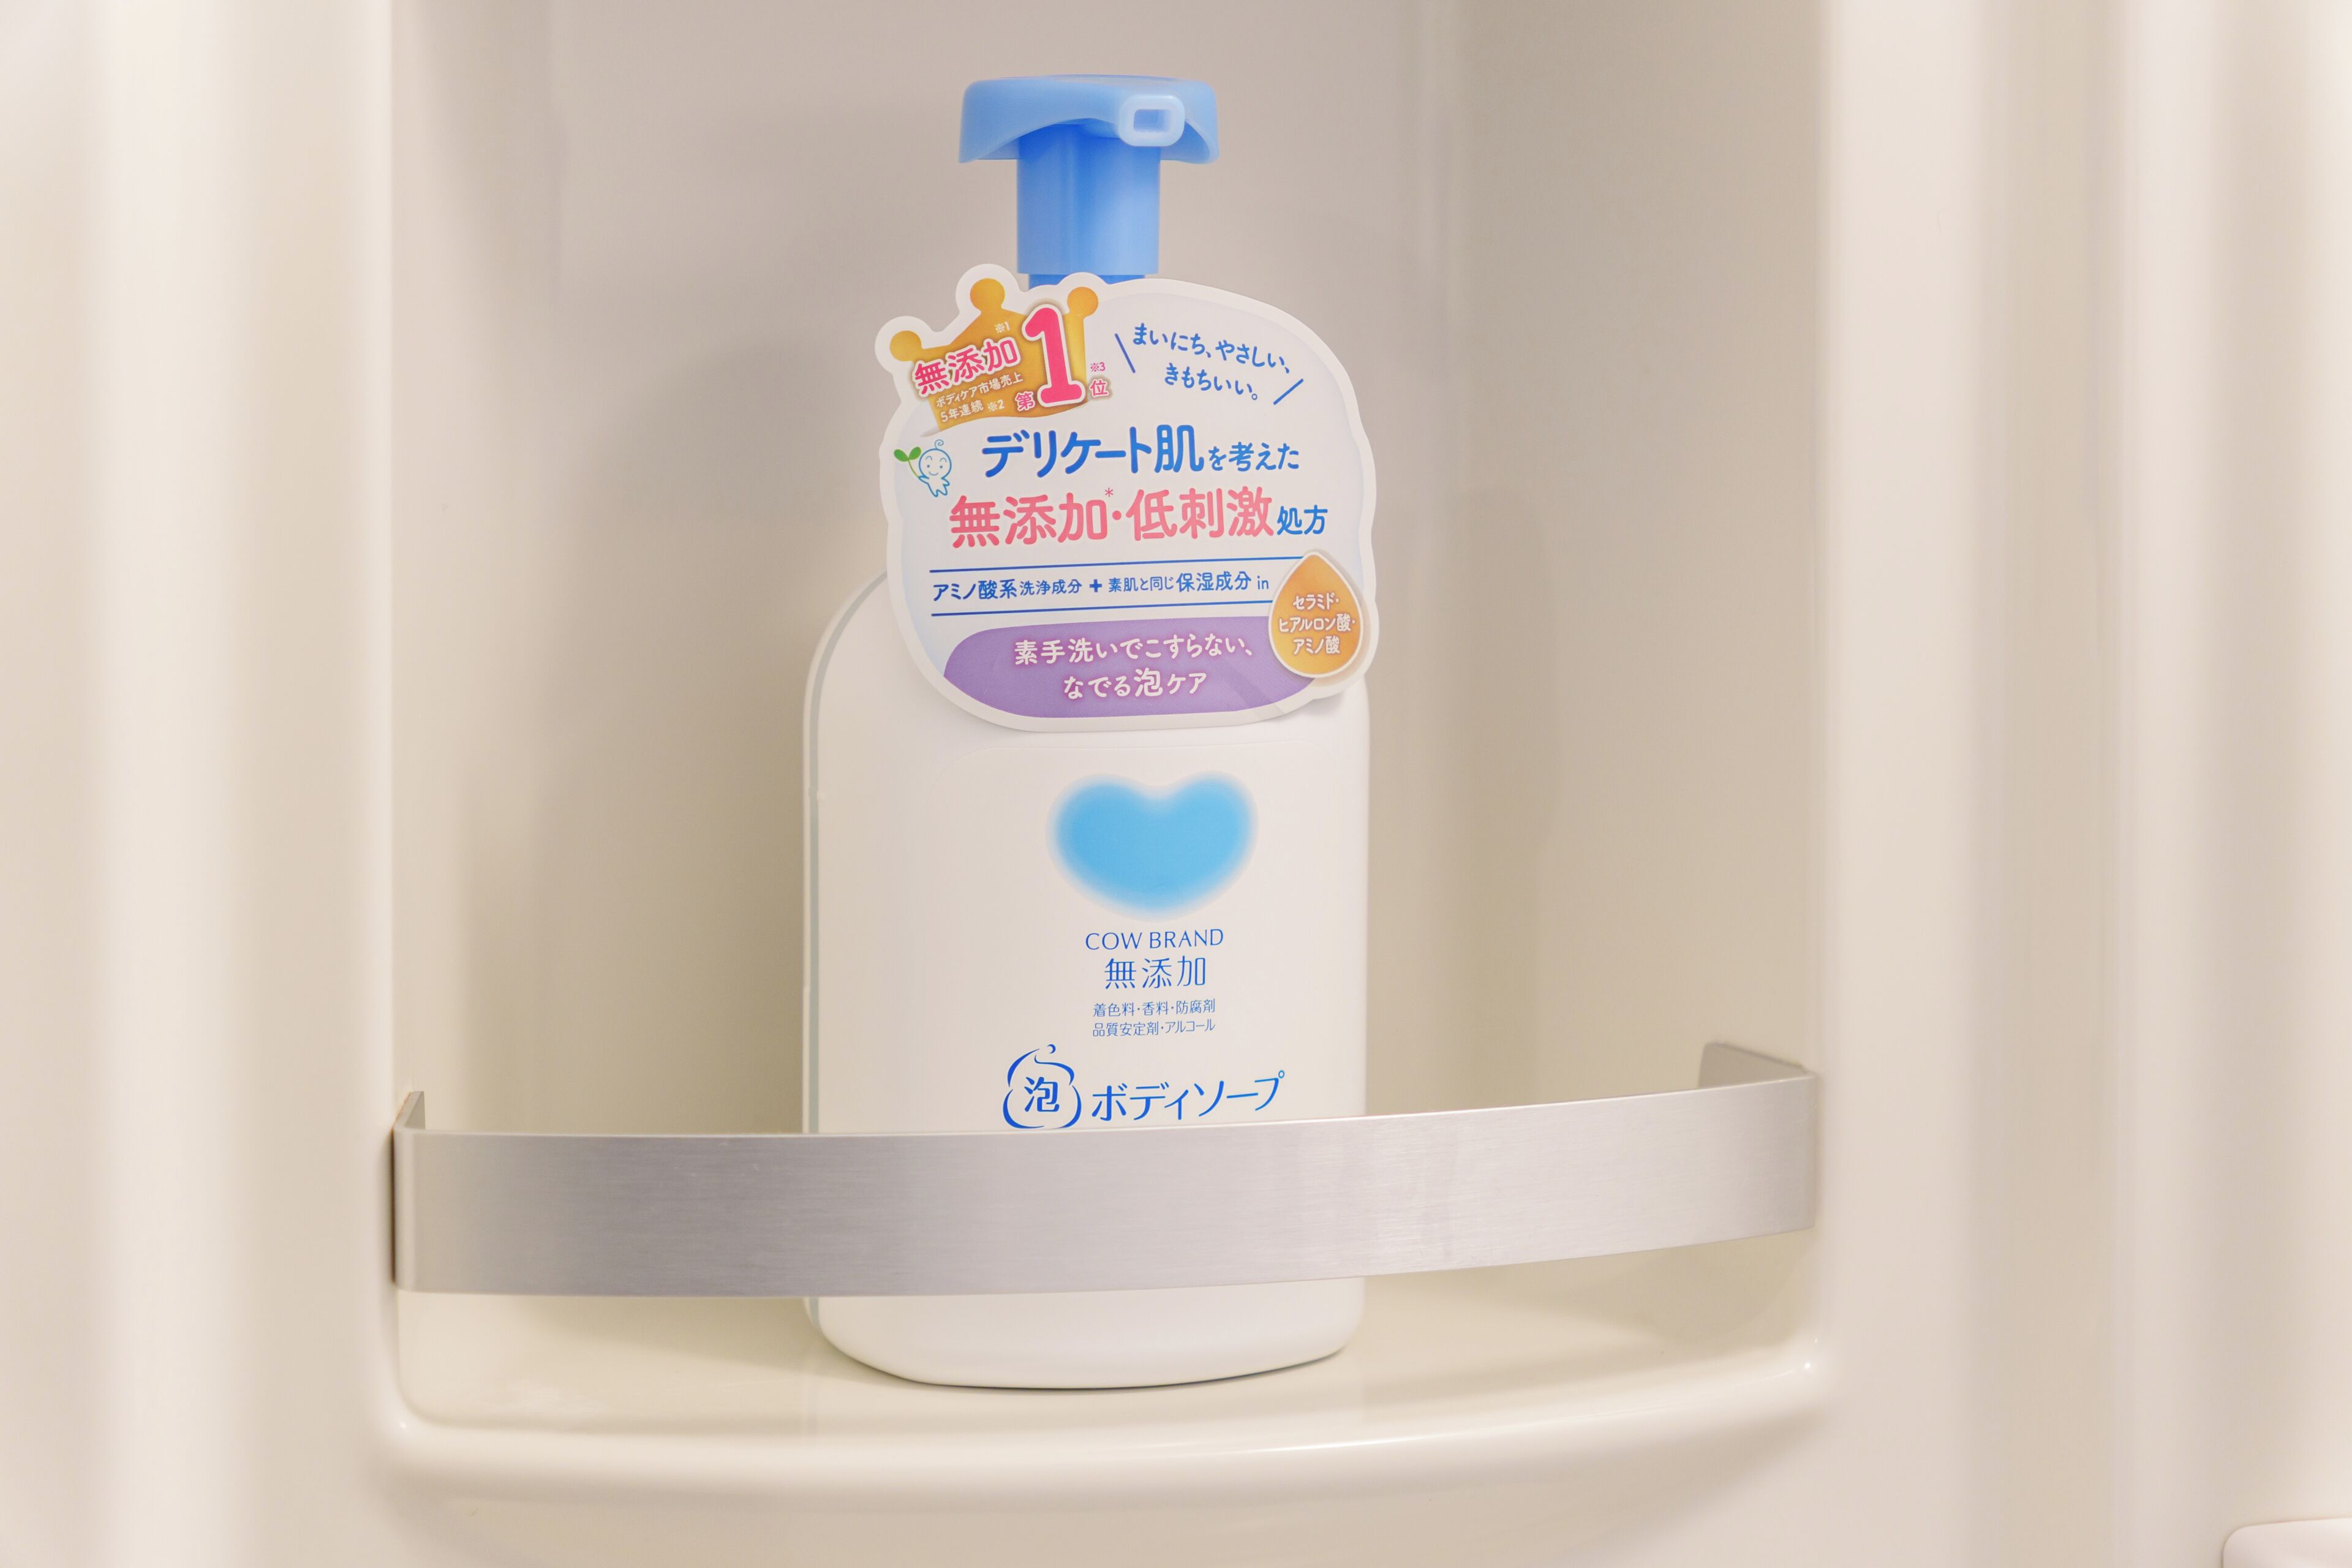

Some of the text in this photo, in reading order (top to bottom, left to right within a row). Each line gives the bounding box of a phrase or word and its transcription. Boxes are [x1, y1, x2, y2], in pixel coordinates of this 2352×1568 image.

[1133, 323, 1291, 373] まいにち、やさしい、
[914, 339, 1019, 395] 無添加
[1164, 363, 1259, 401] きもちいい。
[935, 372, 1023, 409] ボディケア市場売上
[984, 424, 1300, 478] デリケート肌を考えた
[1257, 575, 1269, 590] in
[1015, 634, 1253, 666] 素手洗いでこすらない、
[1292, 636, 1341, 655] アミノ酸
[1064, 668, 1207, 699] なでる泡ケア
[1085, 929, 1224, 950] COW BRAND
[1104, 956, 1206, 990] 無添加
[1093, 998, 1215, 1018] 着色料・香料・防腐剤
[1093, 1019, 1215, 1037] 品質安定剤・アルコール
[1024, 1070, 1284, 1121] 泡 ボディソープ
